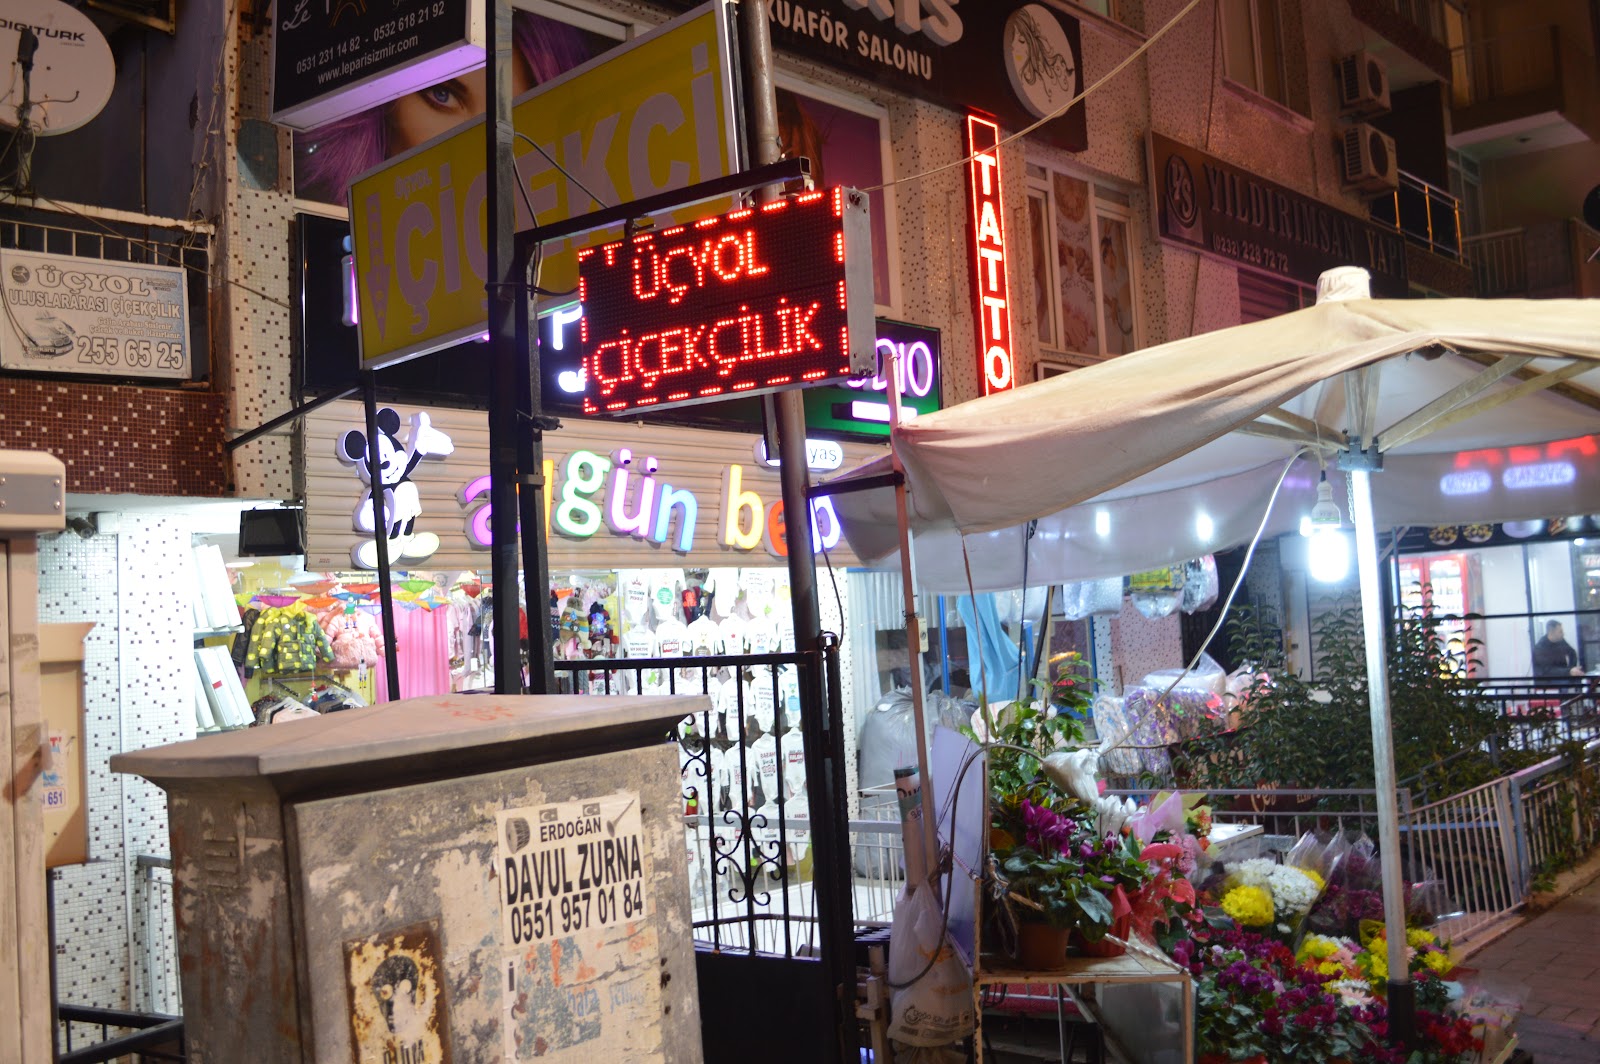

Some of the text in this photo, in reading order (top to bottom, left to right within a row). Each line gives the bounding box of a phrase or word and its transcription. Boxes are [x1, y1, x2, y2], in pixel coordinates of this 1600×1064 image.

[296, 55, 316, 75] 0531
[318, 48, 334, 65] 231
[337, 42, 347, 57] 14
[350, 36, 361, 53] 82
[373, 20, 396, 42] 0532
[398, 12, 416, 32] 618
[418, 7, 430, 24] 21
[432, 1, 445, 18] 92
[317, 34, 419, 85] www.leparisizmir.com
[857, 29, 932, 80] SALONU
[35, 264, 150, 297] ÜÇYOL
[632, 229, 770, 305] ÜÇYOL
[973, 150, 1011, 390] TATTO
[1242, 239, 1262, 265] 228
[1262, 247, 1276, 267] 72
[1277, 253, 1290, 273] 72
[9, 288, 182, 320] ULUSLARARASI ÇİÇEKÇİLİK
[77, 335, 184, 370] 255 65 25
[591, 296, 824, 396] ÇİÇEKÇİLİK
[48, 790, 63, 805] 651
[540, 816, 602, 843] ERDOĞAN
[505, 834, 643, 905] DAVUL ZURNA
[511, 880, 643, 945] 0551 957 01 84
